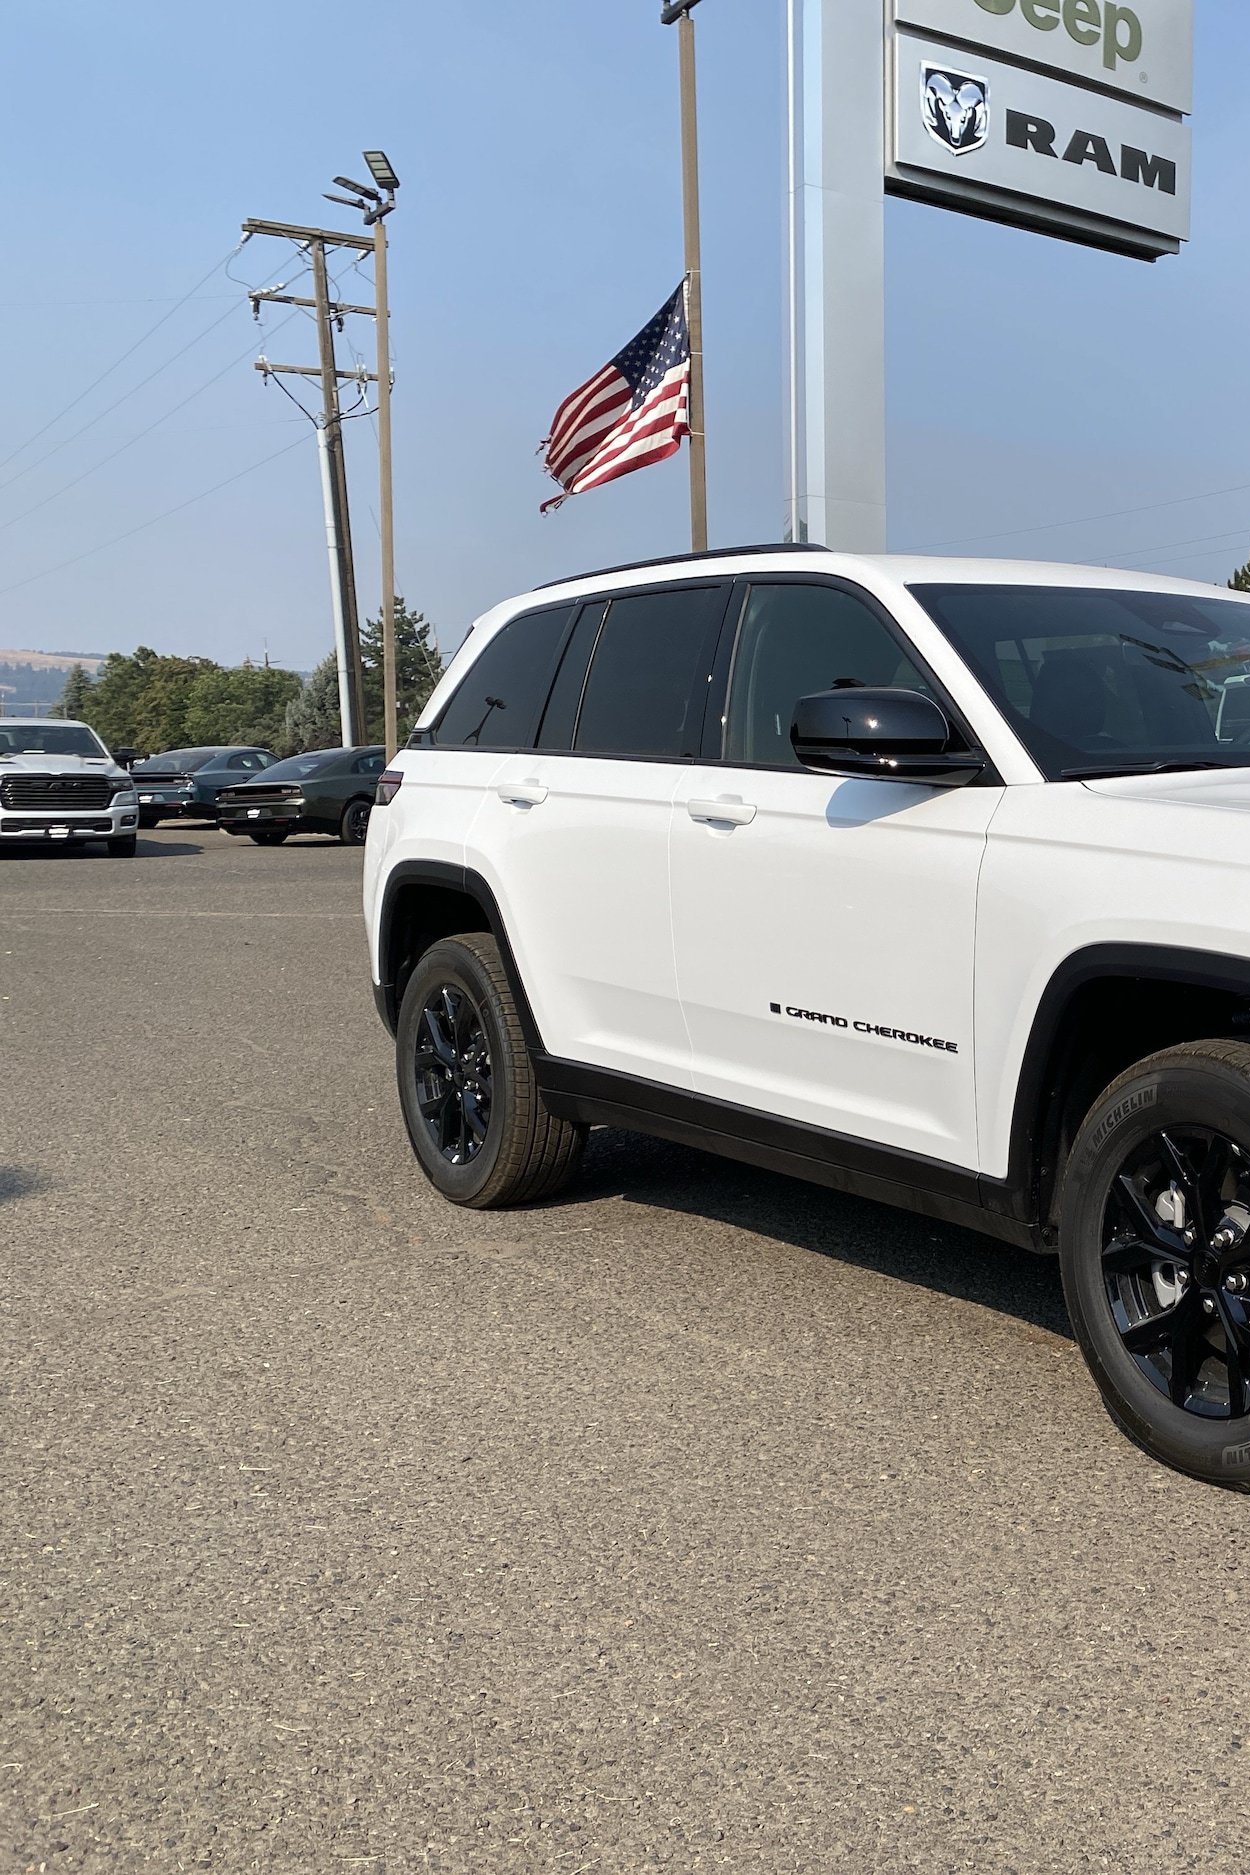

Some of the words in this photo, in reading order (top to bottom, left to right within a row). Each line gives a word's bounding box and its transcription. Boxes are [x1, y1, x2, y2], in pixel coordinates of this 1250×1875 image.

[974, 0, 1143, 71] eep
[1005, 108, 1176, 196] RAM
[786, 1006, 848, 1028] GRAND
[853, 1021, 959, 1054] CHEROKEE
[1092, 1088, 1154, 1148] MICHELIN
